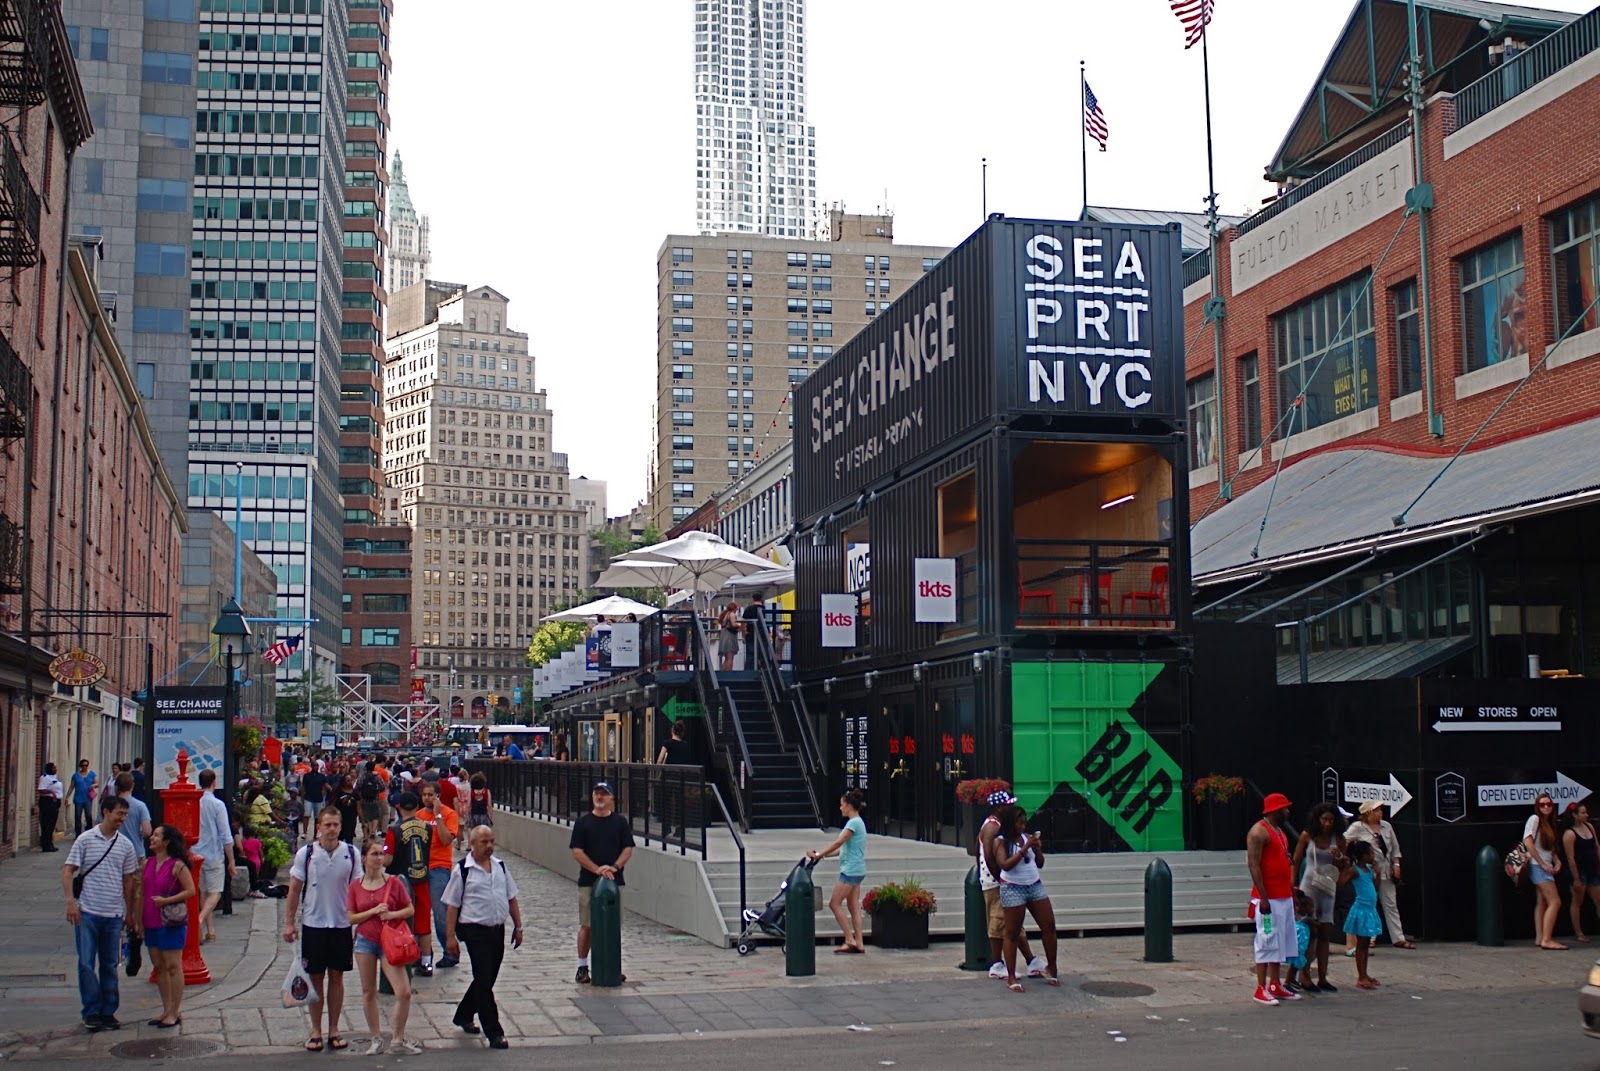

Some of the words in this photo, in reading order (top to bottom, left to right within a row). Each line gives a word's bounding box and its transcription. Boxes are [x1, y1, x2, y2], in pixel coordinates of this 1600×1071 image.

[1238, 221, 1300, 276] FULTON
[1314, 163, 1400, 233] MARKET
[1026, 234, 1145, 283] SEA
[1027, 297, 1149, 343] PRT
[1028, 359, 1152, 409] NYC
[1334, 374, 1350, 395] WHAT
[1335, 394, 1350, 415] EYES
[918, 580, 952, 598] tkts
[824, 612, 852, 627] tkts
[55, 673, 98, 685] BREWERY
[156, 700, 222, 708] SEE/CHANGE
[675, 706, 701, 714] SHOPS
[1439, 707, 1463, 717] NEW
[1478, 707, 1518, 717] STORES
[1530, 707, 1557, 717] OPEN
[859, 749, 867, 760] SEA
[859, 778, 868, 789] NYC
[1074, 719, 1173, 835] BAR
[1346, 785, 1360, 798] OPEN
[1362, 787, 1381, 800] EVERY
[1382, 788, 1404, 802] SUNDAY
[1480, 789, 1507, 802] OPEN
[1510, 788, 1541, 801] EVERY
[1543, 786, 1580, 800] SUNDAY
